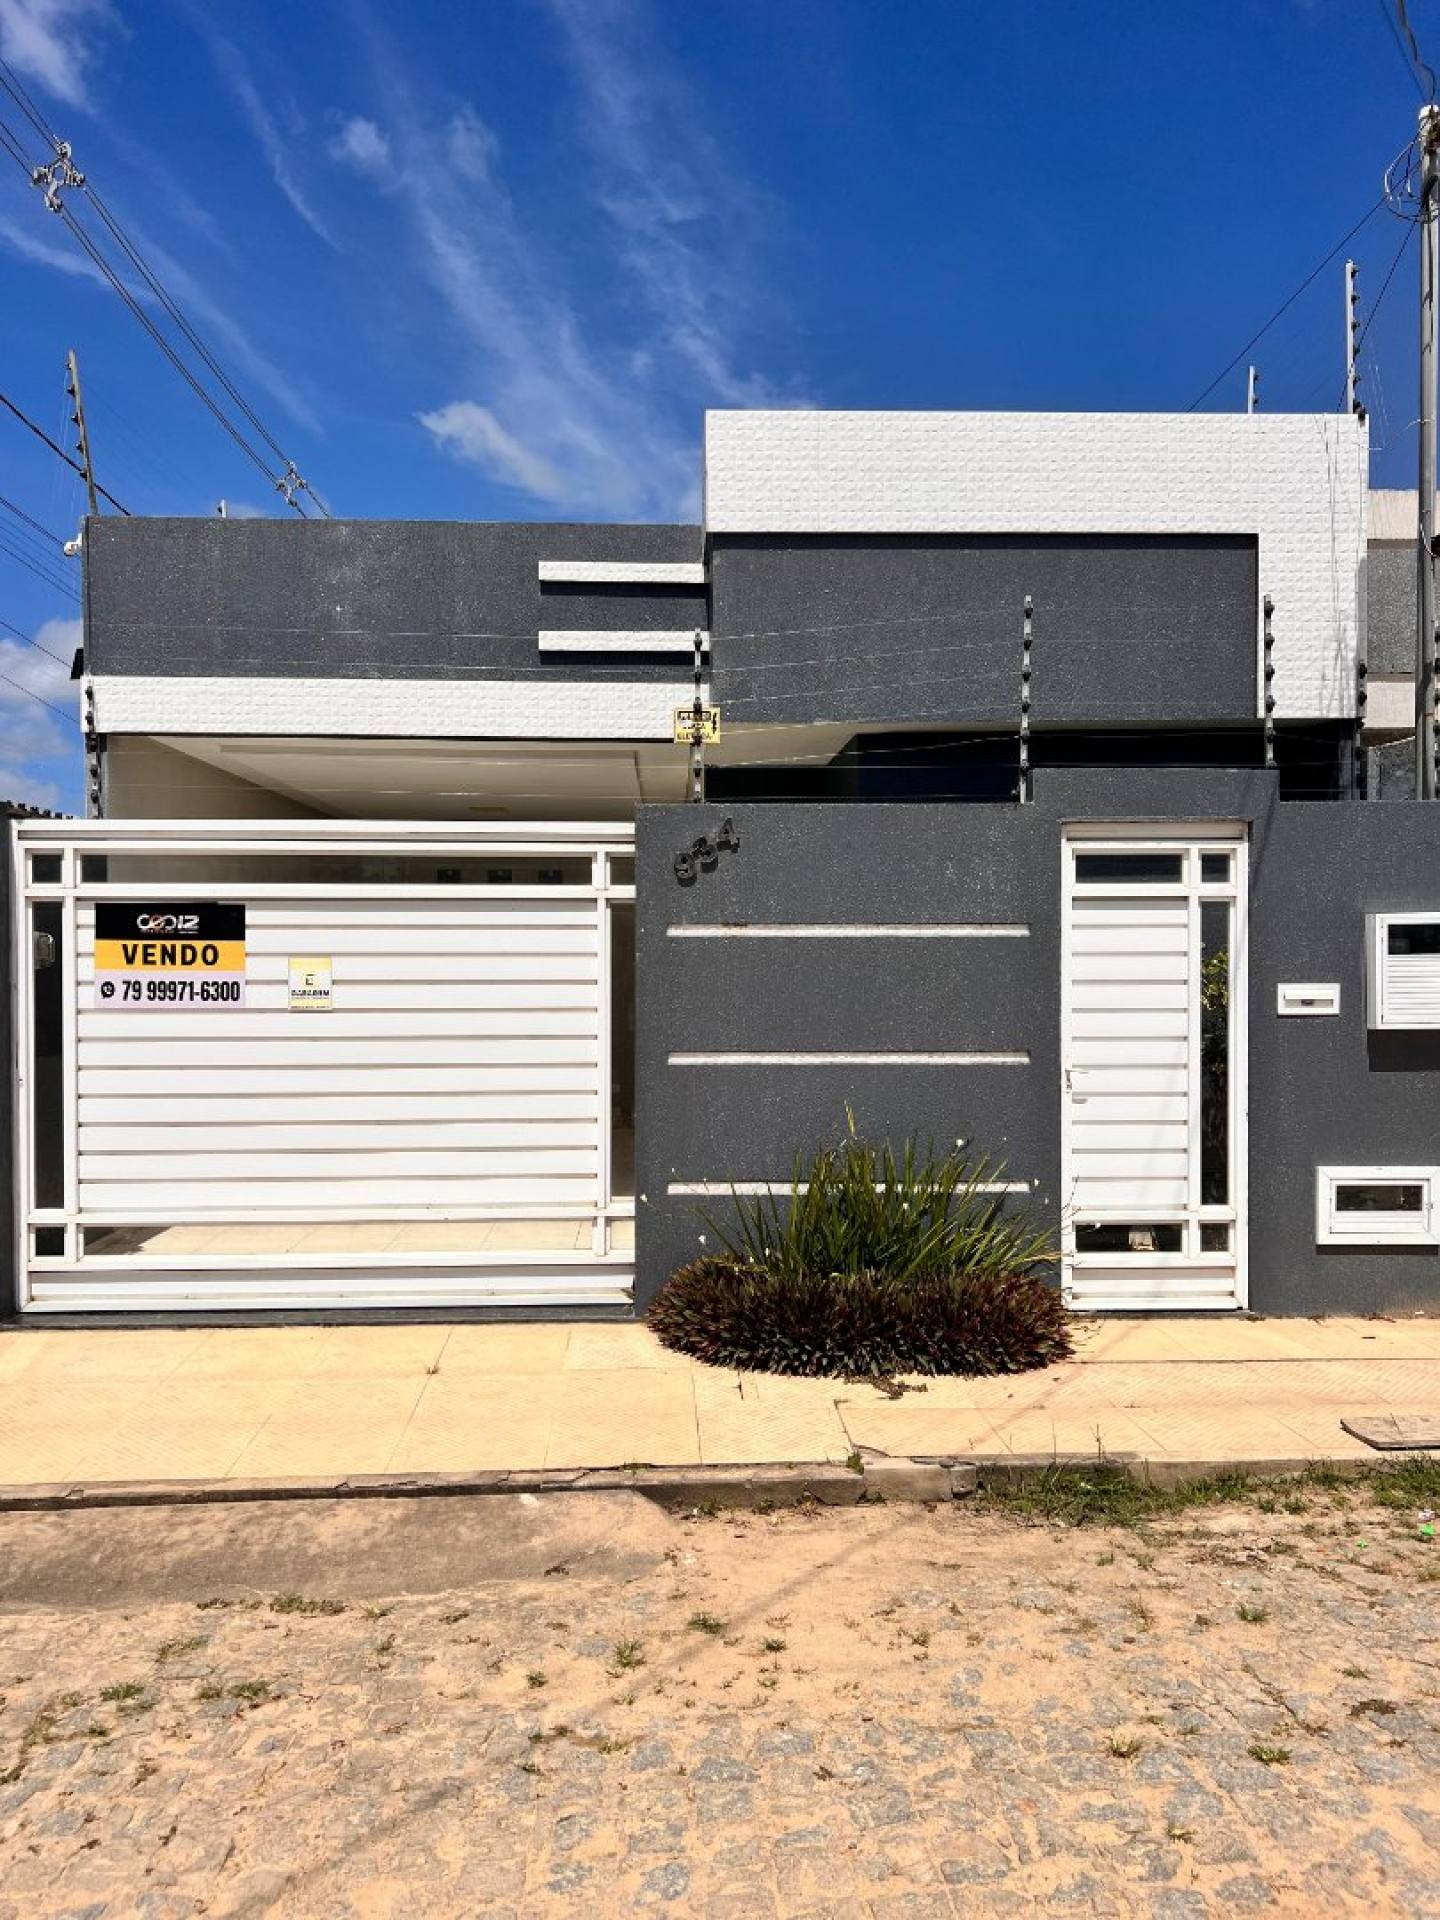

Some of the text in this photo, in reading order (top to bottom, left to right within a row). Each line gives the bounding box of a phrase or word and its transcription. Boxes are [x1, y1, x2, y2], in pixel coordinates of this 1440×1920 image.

[121, 943, 219, 966] VENDO
[122, 980, 241, 1001] 79 99971-6300
